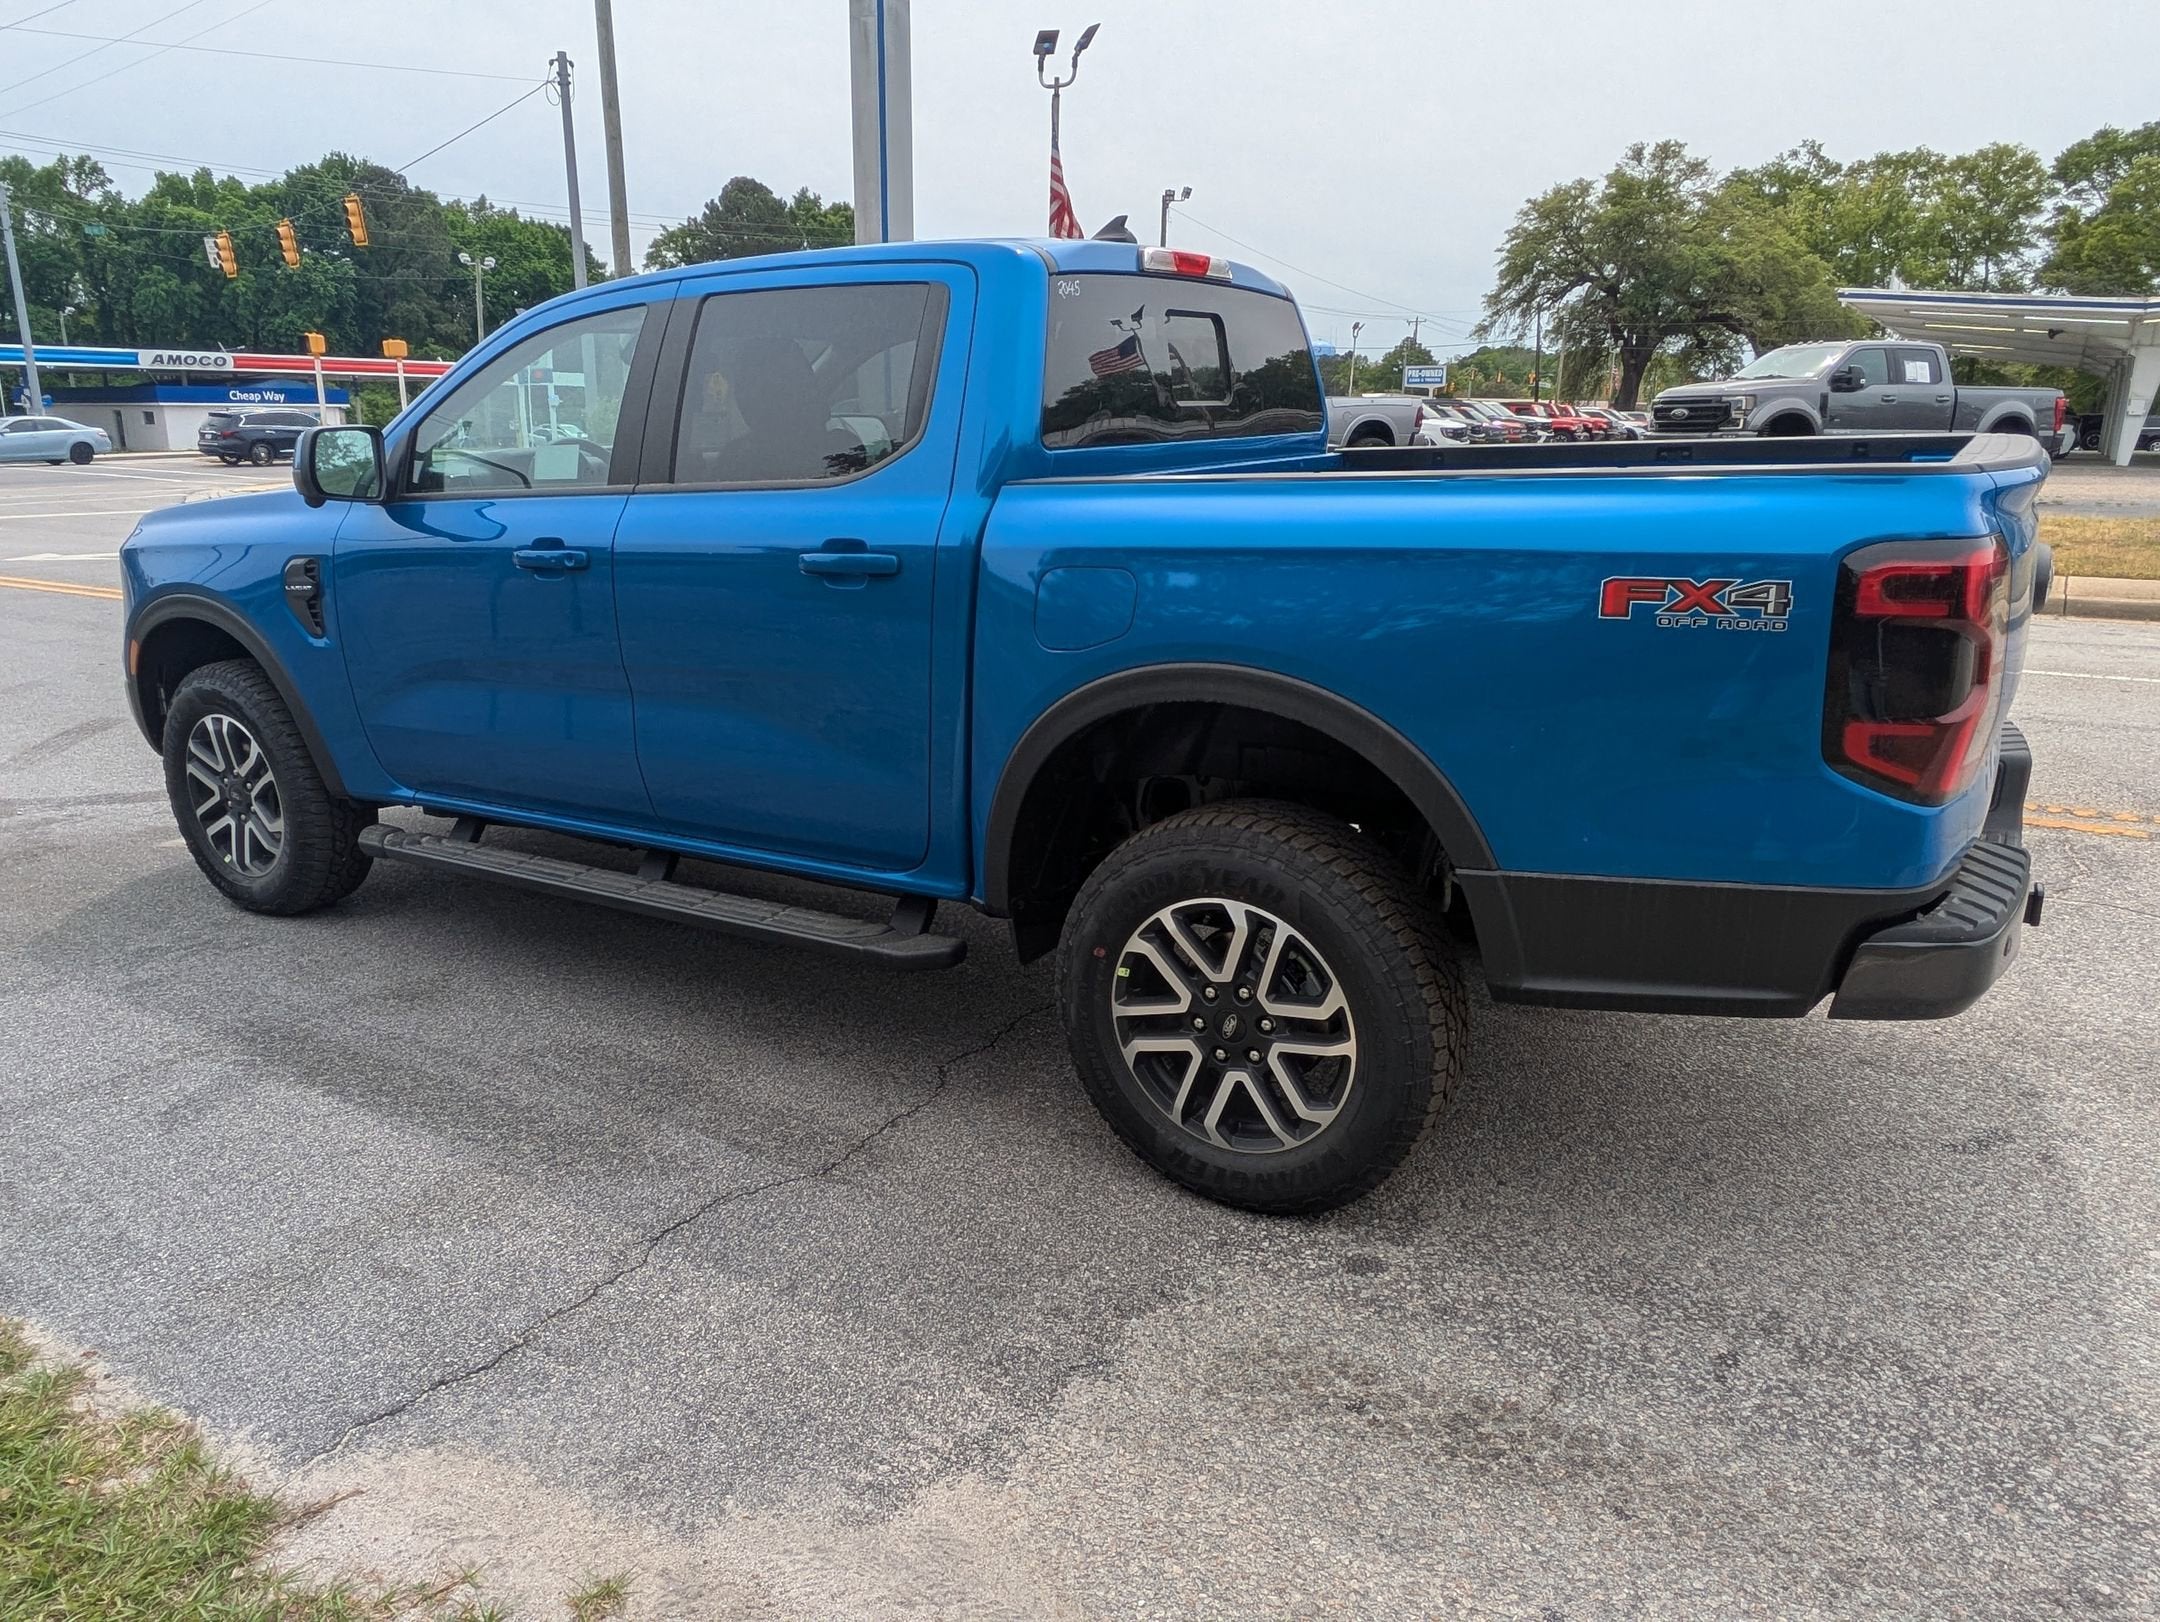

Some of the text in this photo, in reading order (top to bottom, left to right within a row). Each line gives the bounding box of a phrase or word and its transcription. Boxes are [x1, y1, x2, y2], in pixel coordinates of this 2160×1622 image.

[152, 354, 227, 367] AMOCO
[229, 390, 286, 403] Cheap Way
[1598, 575, 1793, 619] FX4
[1656, 615, 1788, 632] OFF ROAD
